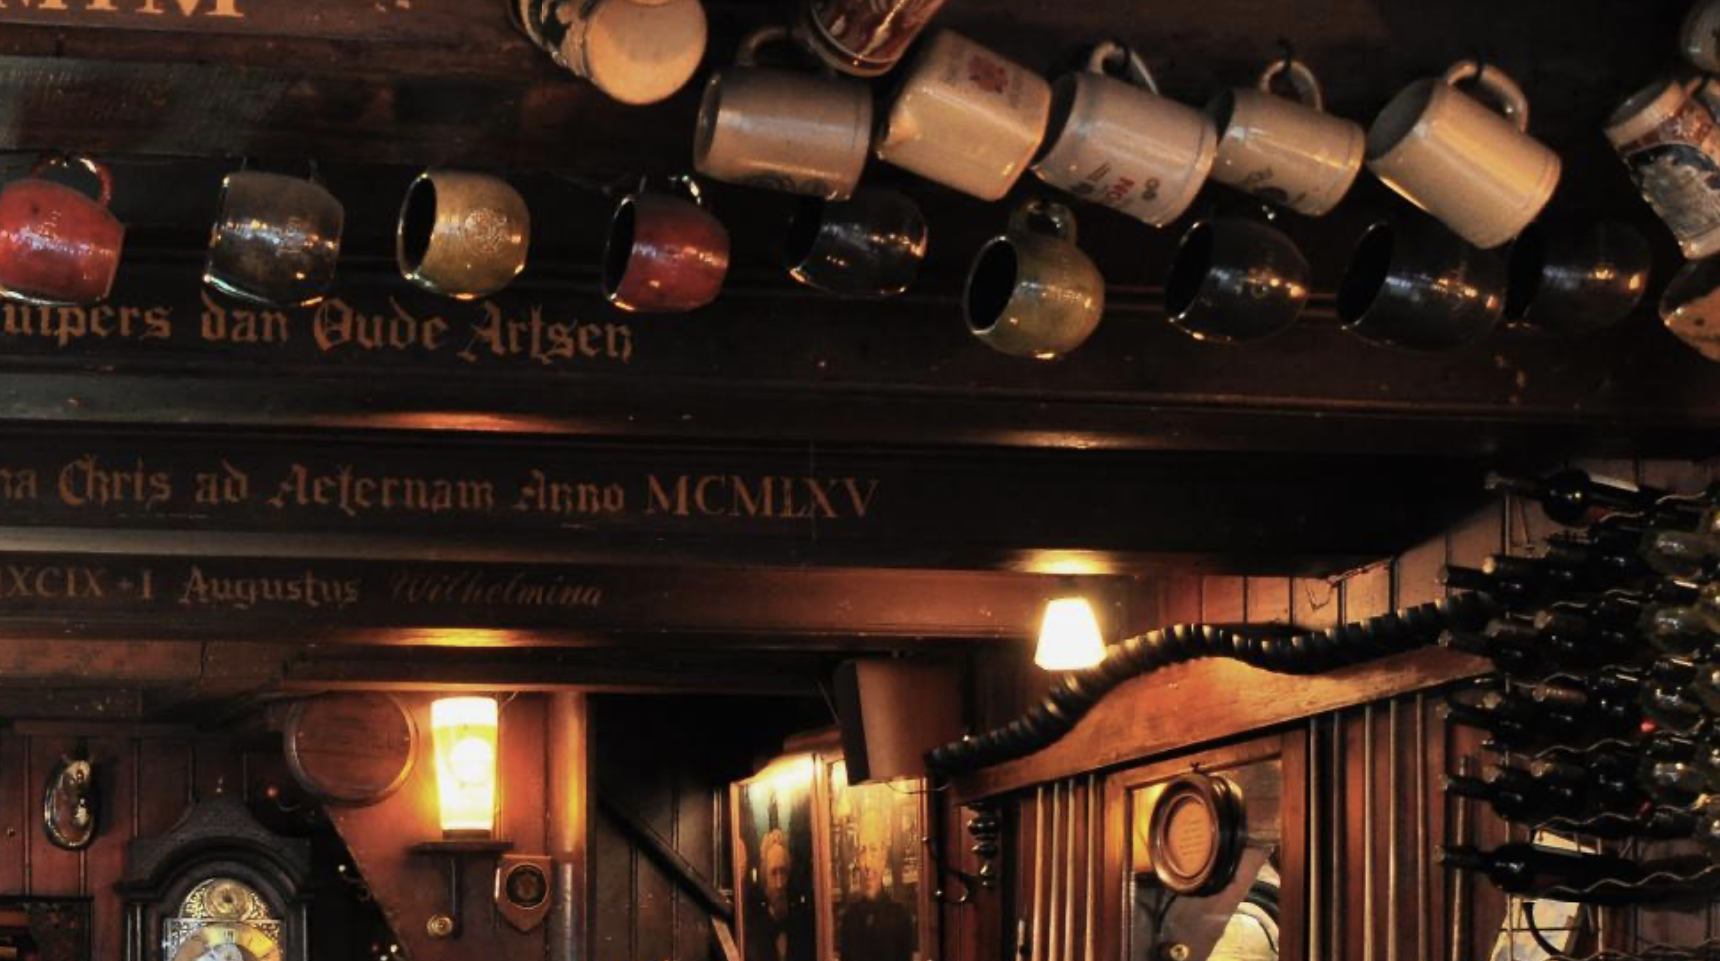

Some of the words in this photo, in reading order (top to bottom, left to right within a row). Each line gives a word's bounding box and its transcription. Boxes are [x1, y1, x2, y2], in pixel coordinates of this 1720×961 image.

[200, 292, 288, 344] dan
[312, 295, 447, 351] Oude
[457, 303, 633, 363] Artsen
[58, 454, 173, 506] Chris
[195, 460, 248, 505] ad
[266, 463, 494, 516] Aeternam
[511, 468, 625, 514] Anno
[644, 474, 881, 519] MCMLXV
[177, 566, 361, 610] Augustus
[388, 568, 608, 608] Wilhelmina
